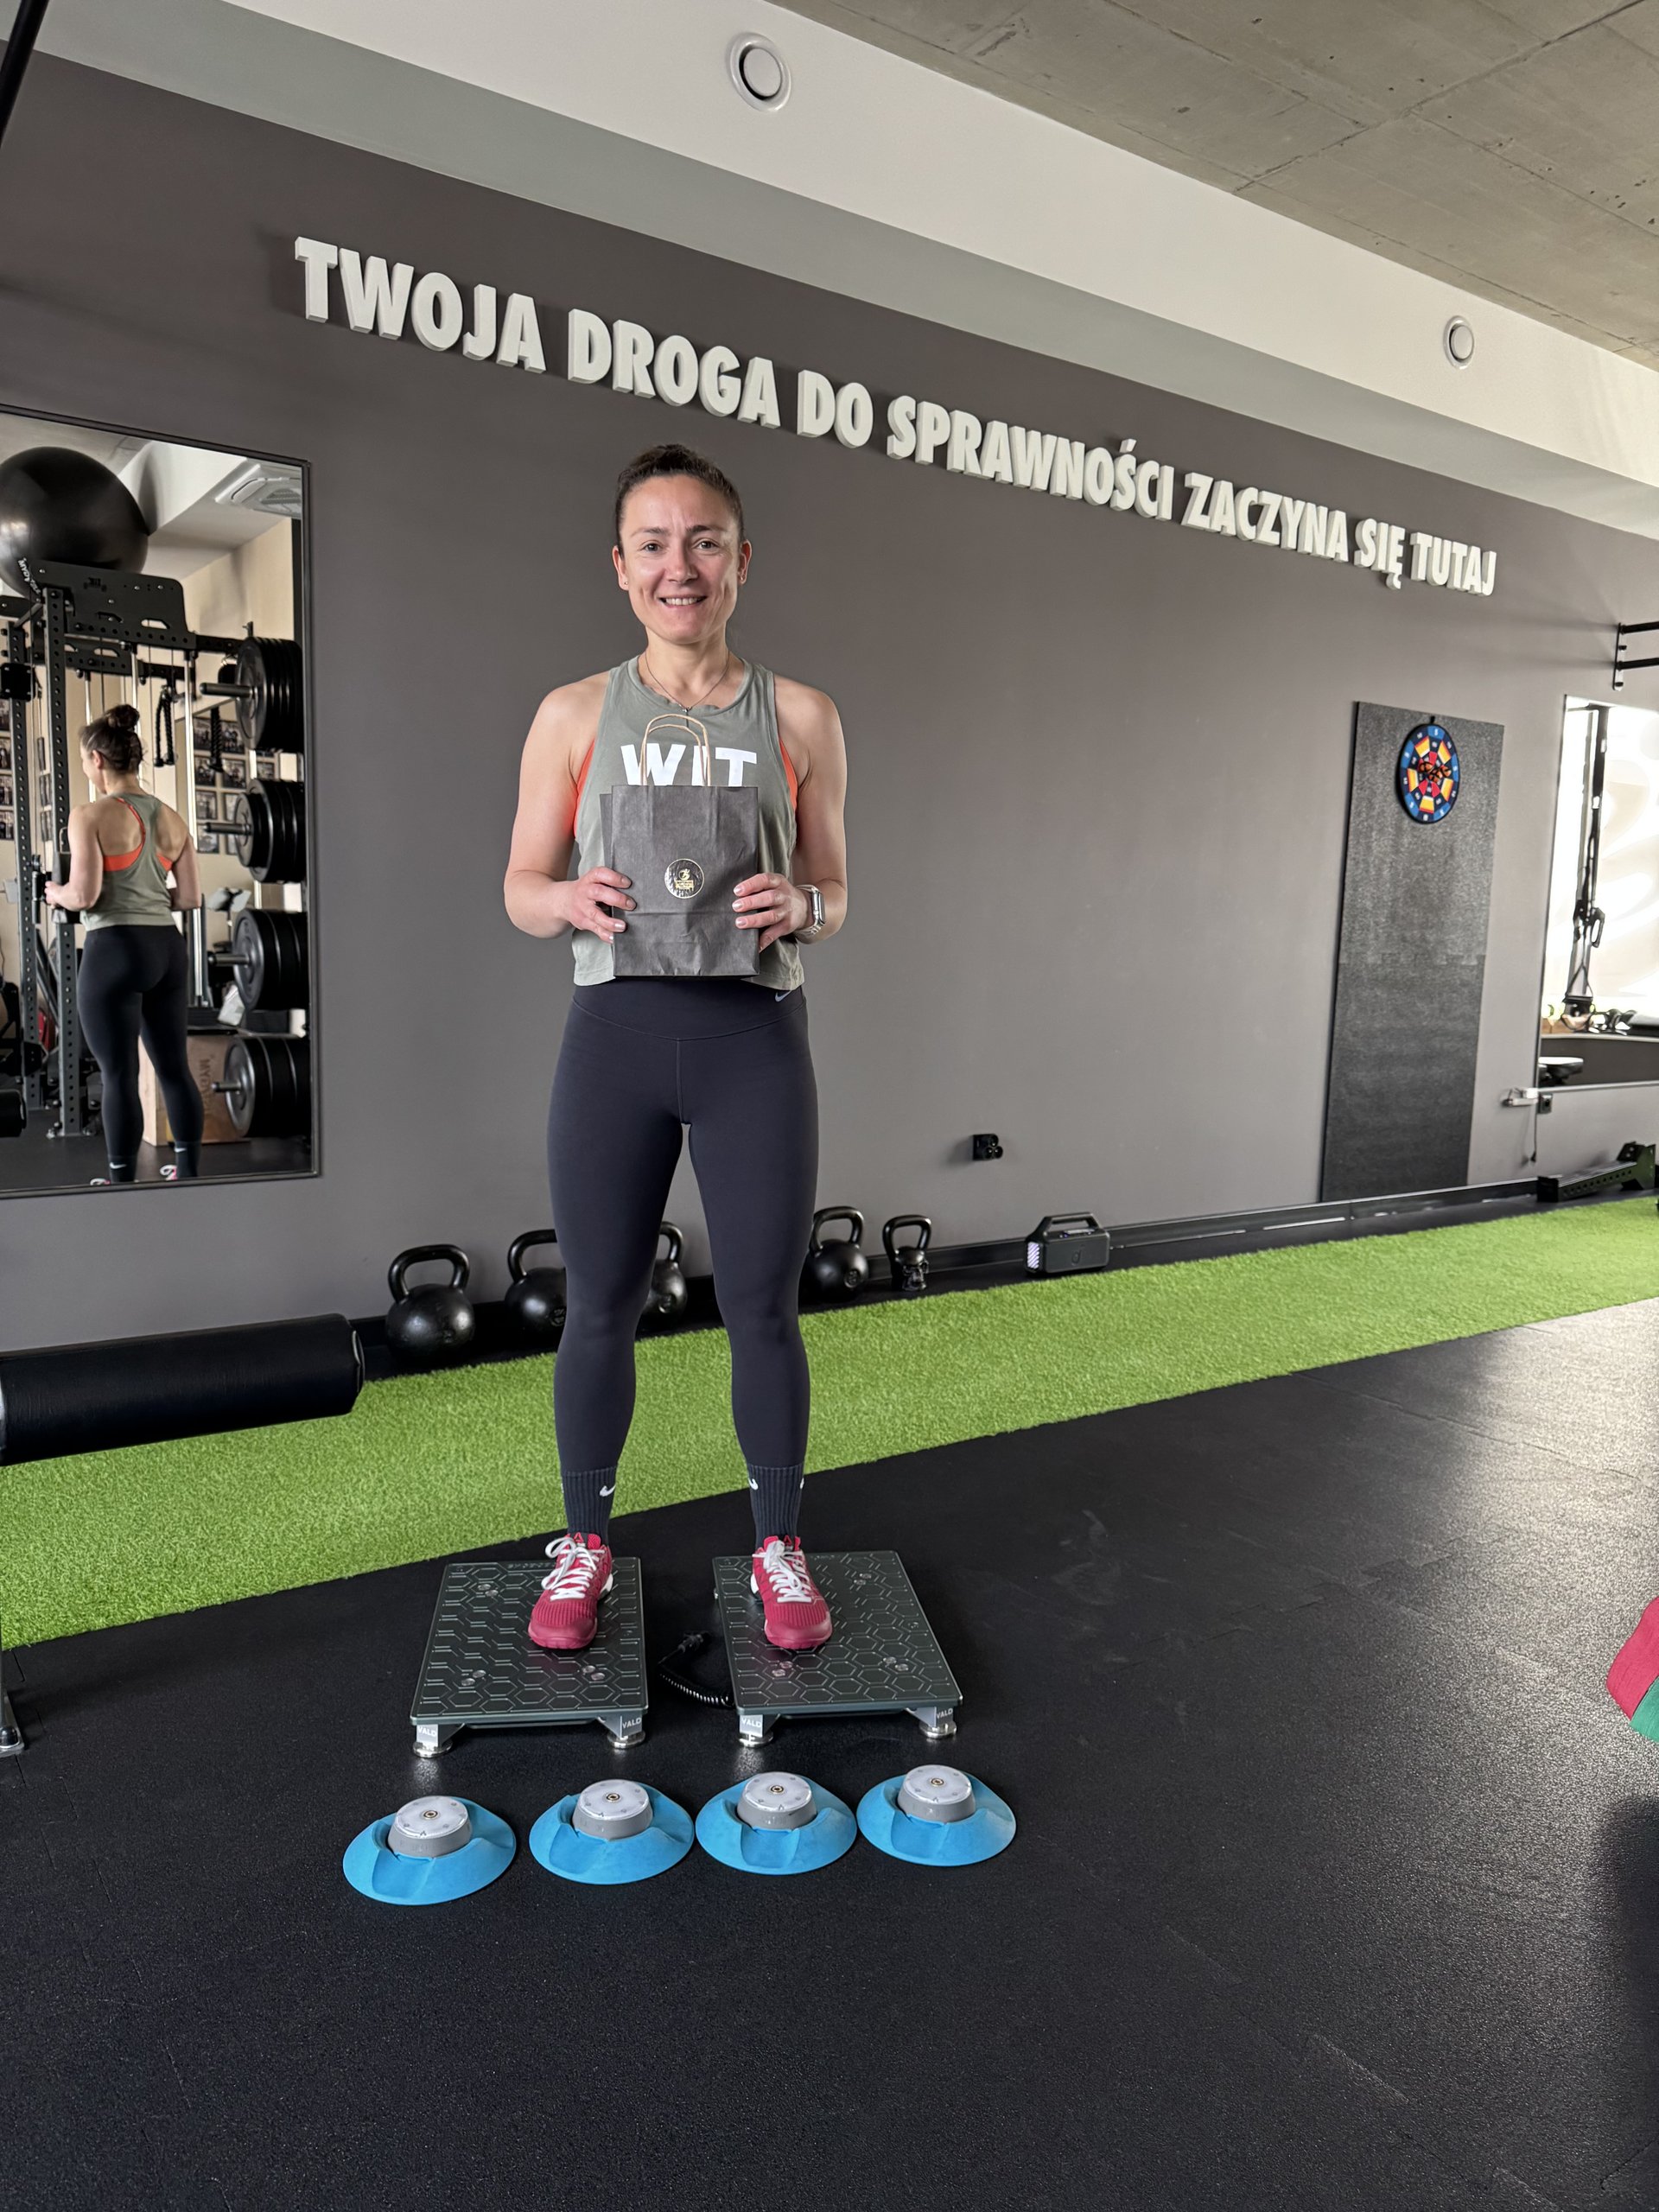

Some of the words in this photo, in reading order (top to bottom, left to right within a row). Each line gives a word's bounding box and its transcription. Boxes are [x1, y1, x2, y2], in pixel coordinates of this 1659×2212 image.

[295, 237, 546, 373] TWOJA
[568, 308, 781, 429] DROGA
[797, 369, 874, 448] DO
[887, 395, 1174, 521] SPRAWNOŚCI
[1180, 472, 1349, 563] ZACZYNA
[1353, 518, 1406, 590] SIĘ
[1410, 531, 1497, 596] TUTAJ
[937, 1707, 954, 1719] VALD
[622, 1717, 642, 1729] VALD
[741, 1716, 762, 1728] VALD
[417, 1726, 437, 1738] VALD
